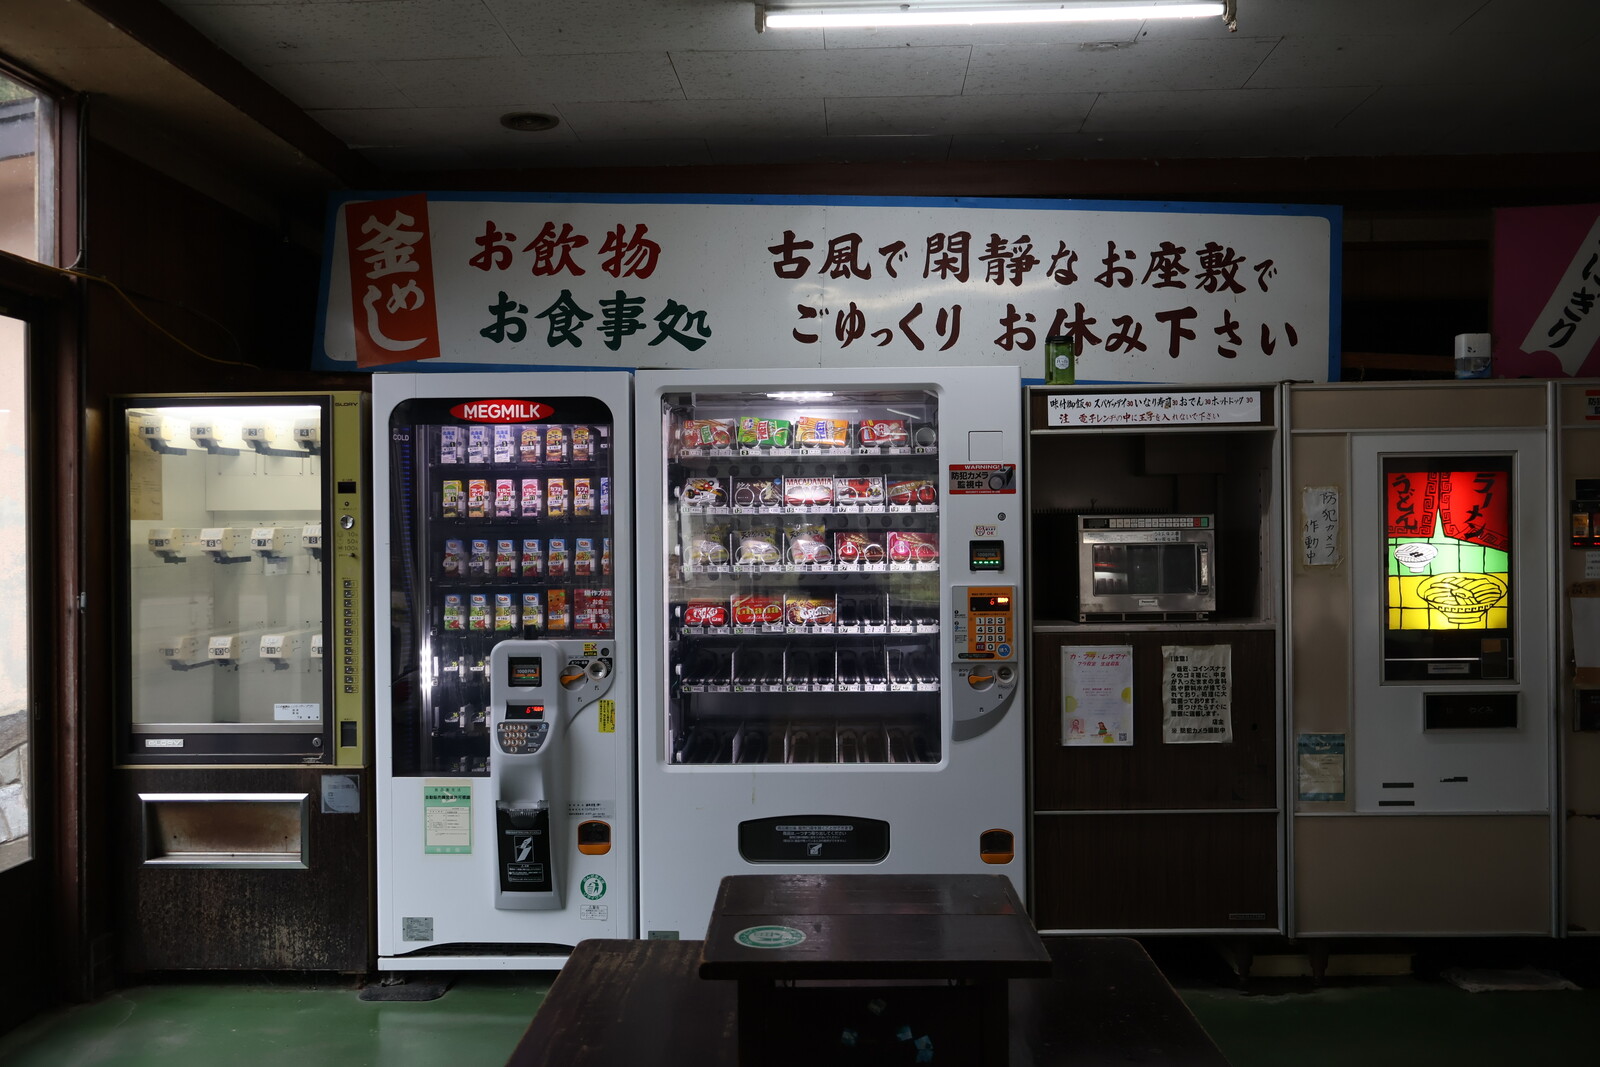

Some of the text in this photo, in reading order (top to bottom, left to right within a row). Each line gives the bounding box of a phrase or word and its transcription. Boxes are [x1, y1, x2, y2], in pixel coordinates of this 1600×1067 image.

[468, 220, 661, 280] お飲物
[355, 209, 427, 352] 釜めし
[479, 288, 713, 352] お食事処
[792, 301, 1298, 359] ごゆっくり お休み下さい
[463, 404, 541, 421] MEGMILK
[1179, 396, 1204, 406] おでん
[951, 471, 989, 480] 防犯カメラ
[957, 480, 983, 489] 監視中
[1392, 474, 1417, 531] うどん
[1320, 492, 1337, 557] 防犯カメラ
[1464, 473, 1497, 539] ラーメン
[1304, 518, 1319, 564] 作動中
